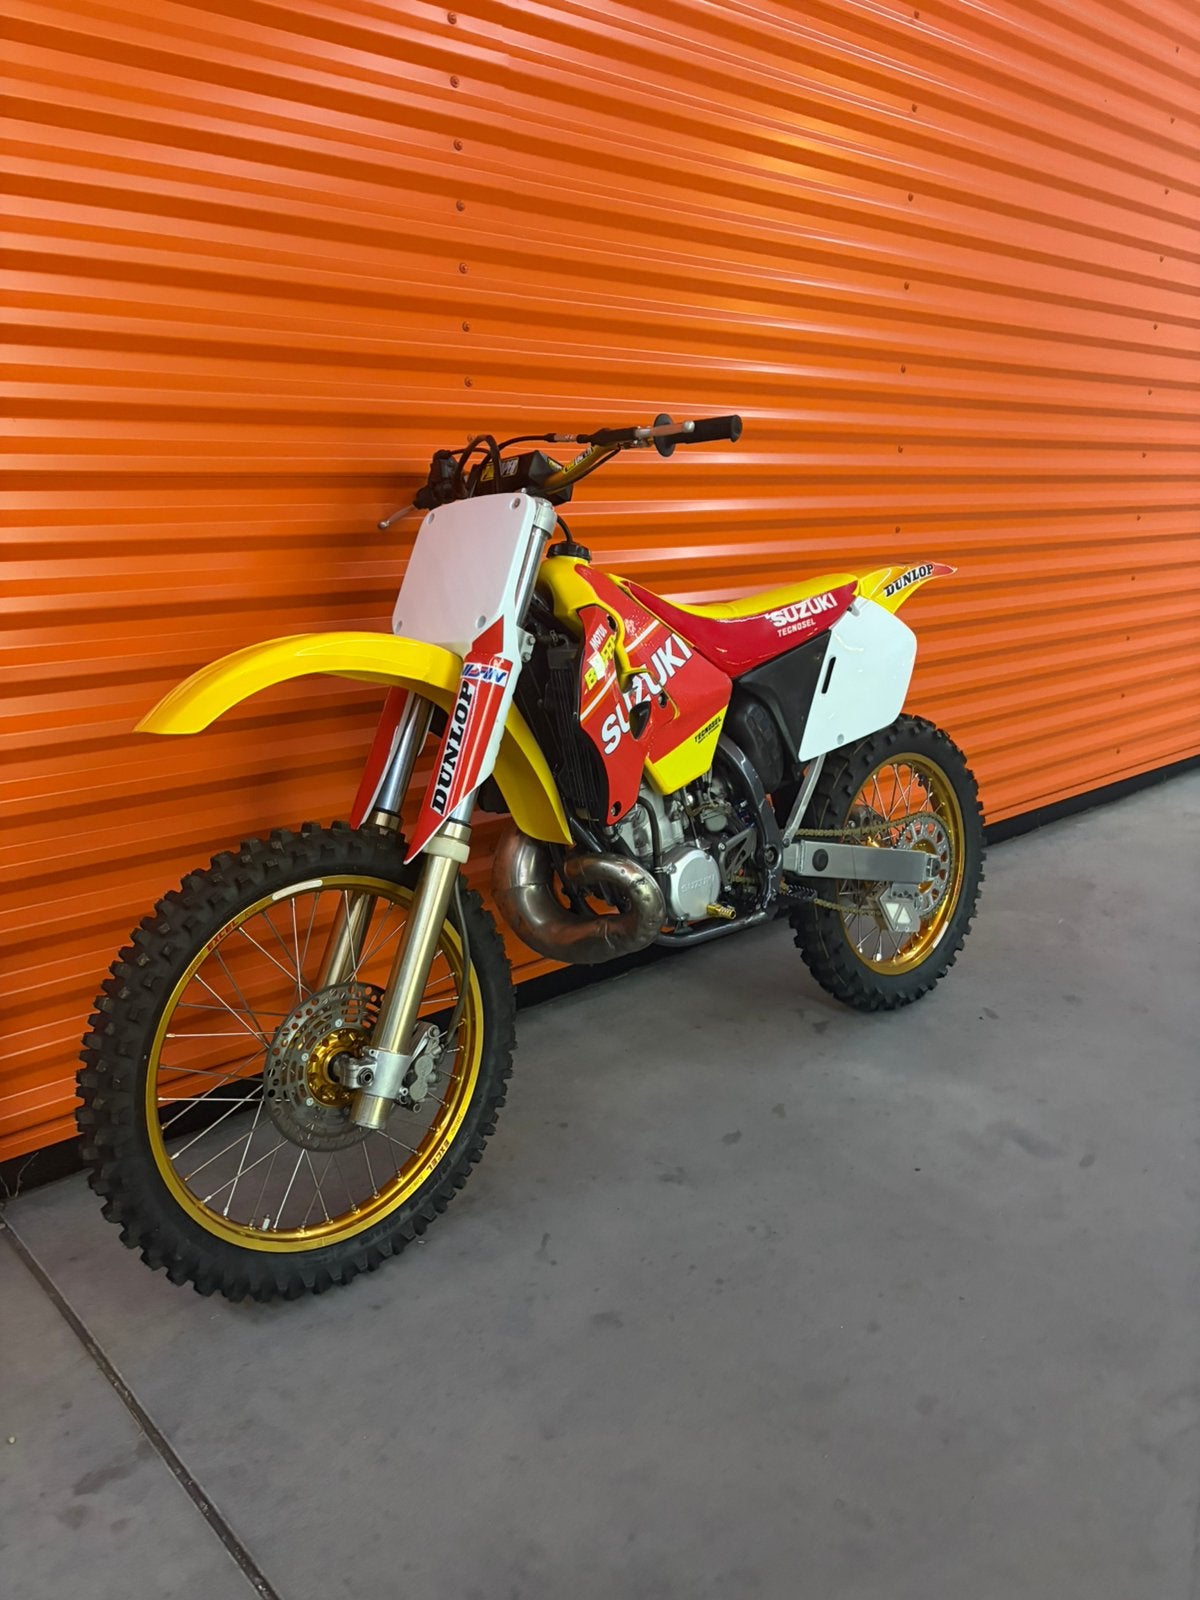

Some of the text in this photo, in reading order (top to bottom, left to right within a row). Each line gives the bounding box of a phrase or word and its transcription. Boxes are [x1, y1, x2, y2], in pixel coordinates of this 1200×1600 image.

[884, 564, 934, 597] DUNLOP
[771, 592, 838, 627] SUZUKI
[590, 624, 608, 650] MOTUL
[777, 618, 816, 638] TECNOSEL
[601, 633, 694, 755] SUZUKI
[431, 680, 474, 815] DUNLOP
